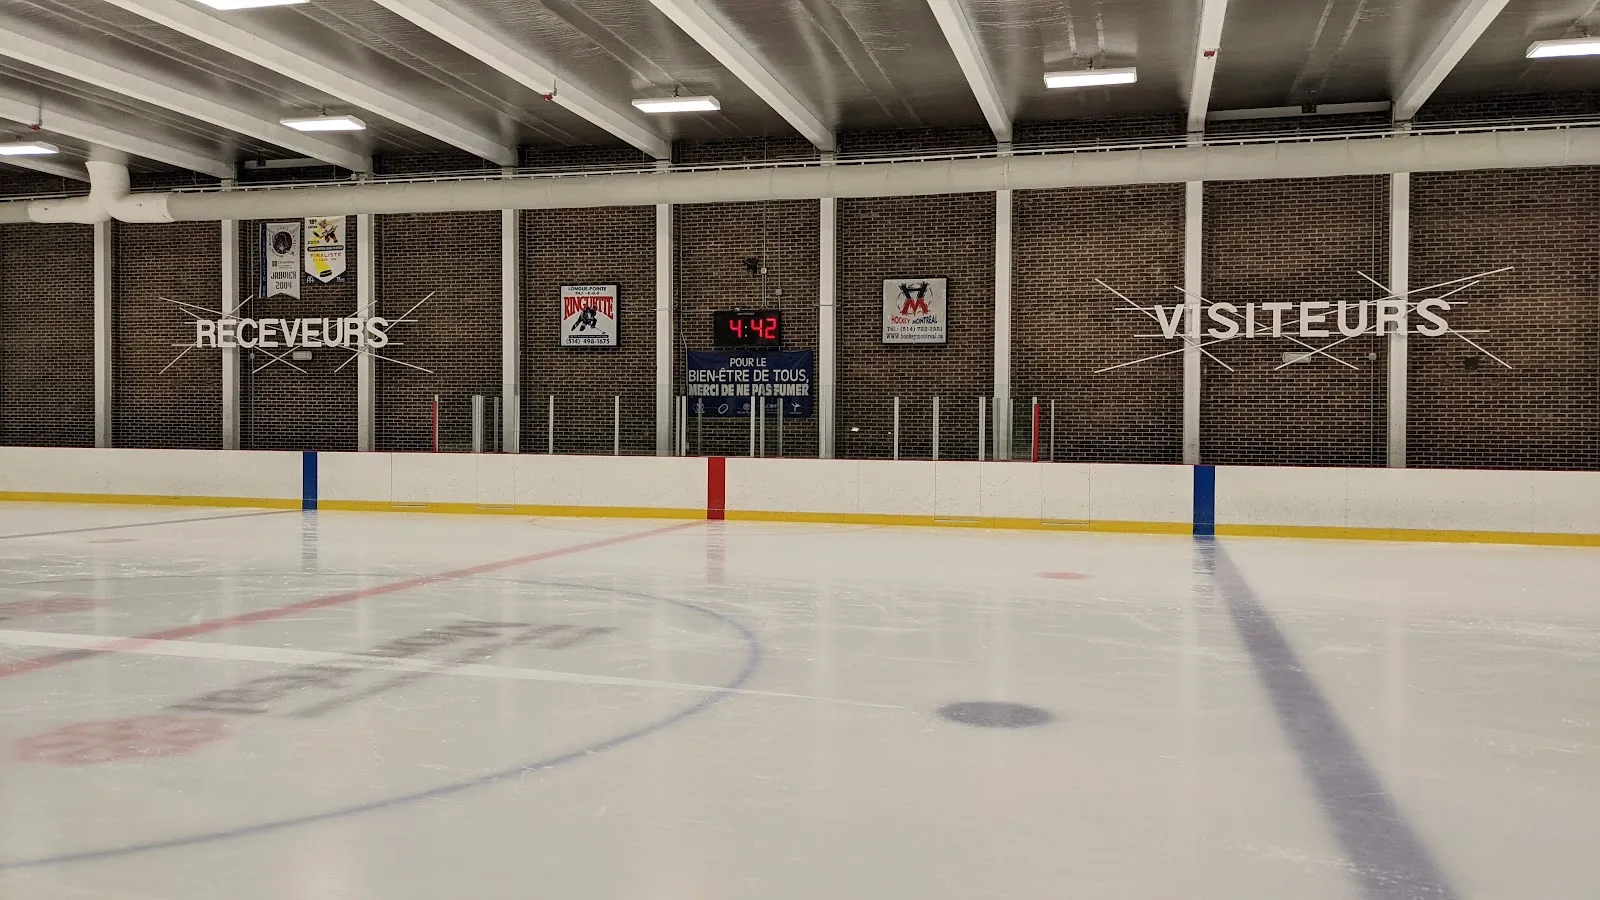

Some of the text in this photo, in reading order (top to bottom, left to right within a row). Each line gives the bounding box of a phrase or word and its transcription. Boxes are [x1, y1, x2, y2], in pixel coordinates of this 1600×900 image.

[270, 271, 297, 279] JANVIER
[275, 281, 292, 290] 2004
[564, 296, 613, 320] RINGUETTE
[1154, 298, 1451, 339] VISITEURS
[196, 316, 389, 348] RECEVEURS
[729, 318, 777, 339] 4:42
[729, 357, 767, 367] POUR LE
[688, 367, 810, 384] BIEN-ÊTRE DE TOUS,
[688, 383, 810, 396] MERCI DE NE PAS FUMER
